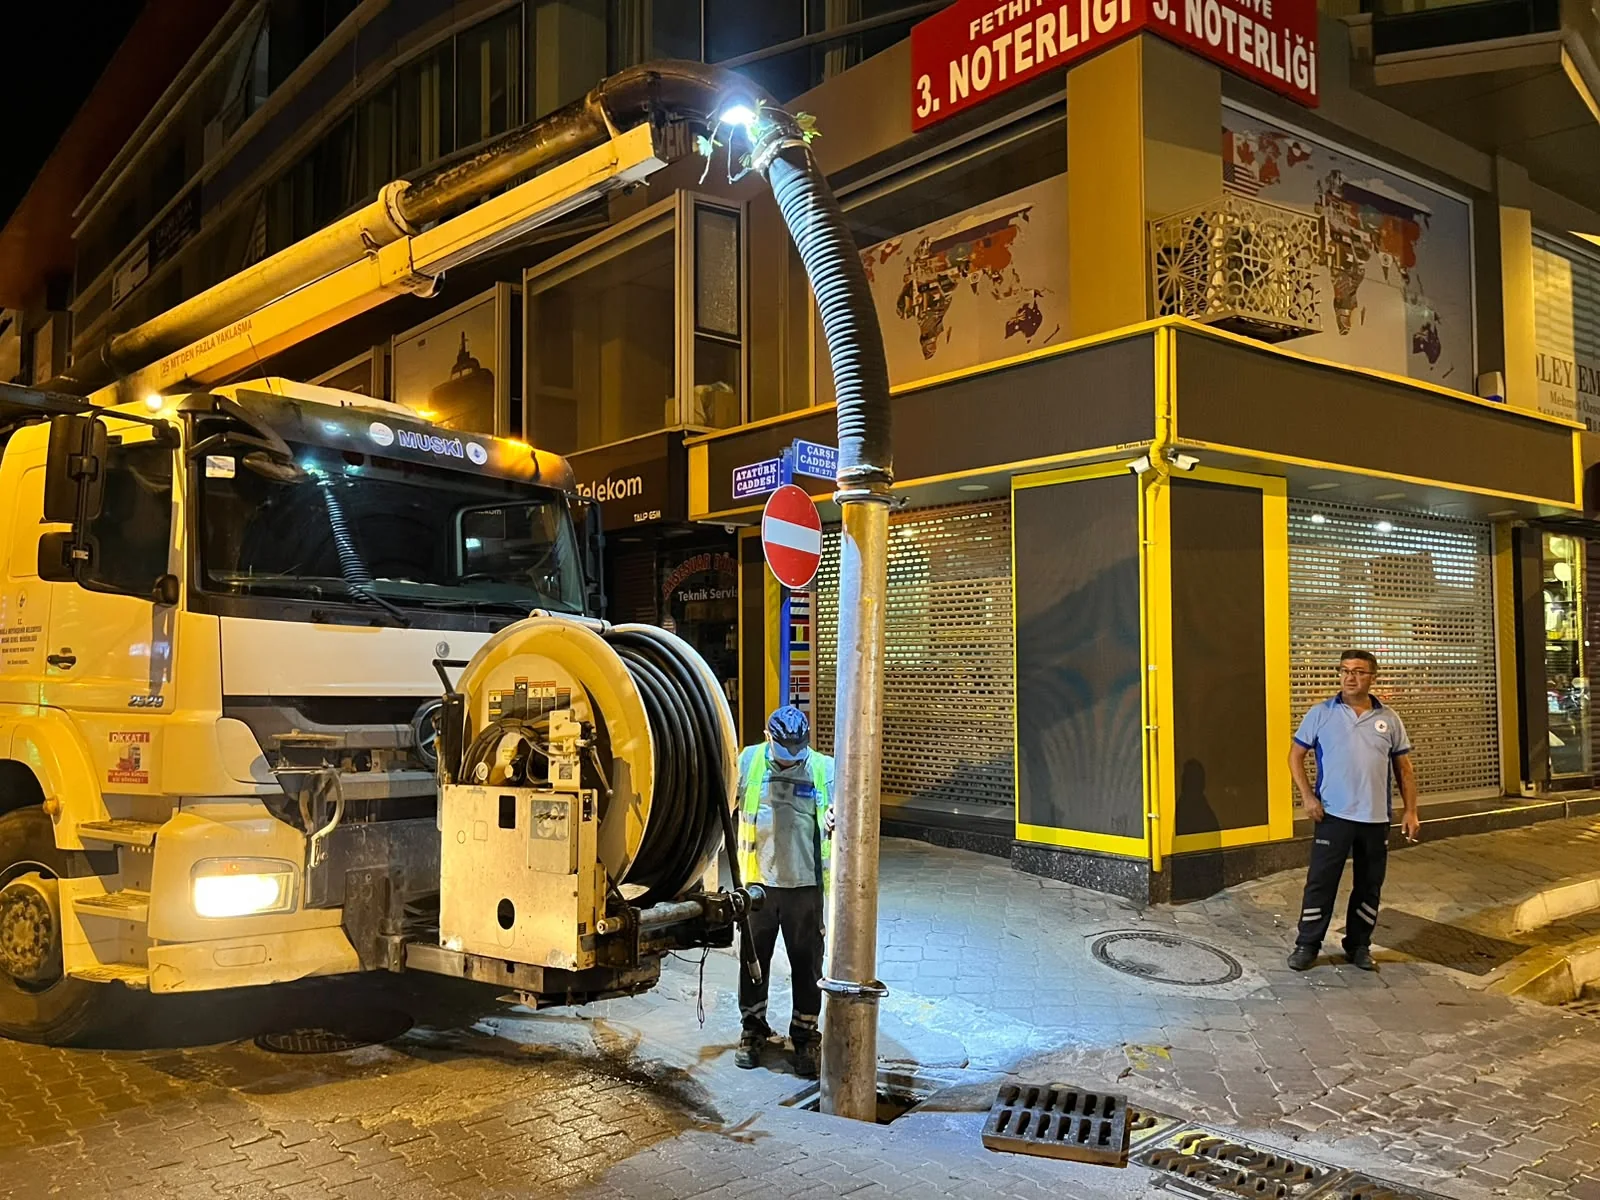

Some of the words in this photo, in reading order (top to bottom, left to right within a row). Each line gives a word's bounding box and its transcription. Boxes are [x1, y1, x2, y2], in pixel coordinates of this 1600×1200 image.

[1185, 0, 1317, 96] NOTERLİĞİ
[916, 74, 940, 118] 3.
[195, 337, 215, 356] FAZLA
[216, 320, 253, 345] YAKLAŞMA
[1536, 353, 1573, 389] LEY
[398, 429, 464, 458] MUSKİ
[807, 446, 835, 460] ÇARŞI
[736, 463, 777, 481] ATATÜRK
[737, 473, 775, 491] CADDESİ
[575, 475, 643, 506] Telekom
[678, 589, 708, 602] Teknik
[128, 695, 164, 708] 2529
